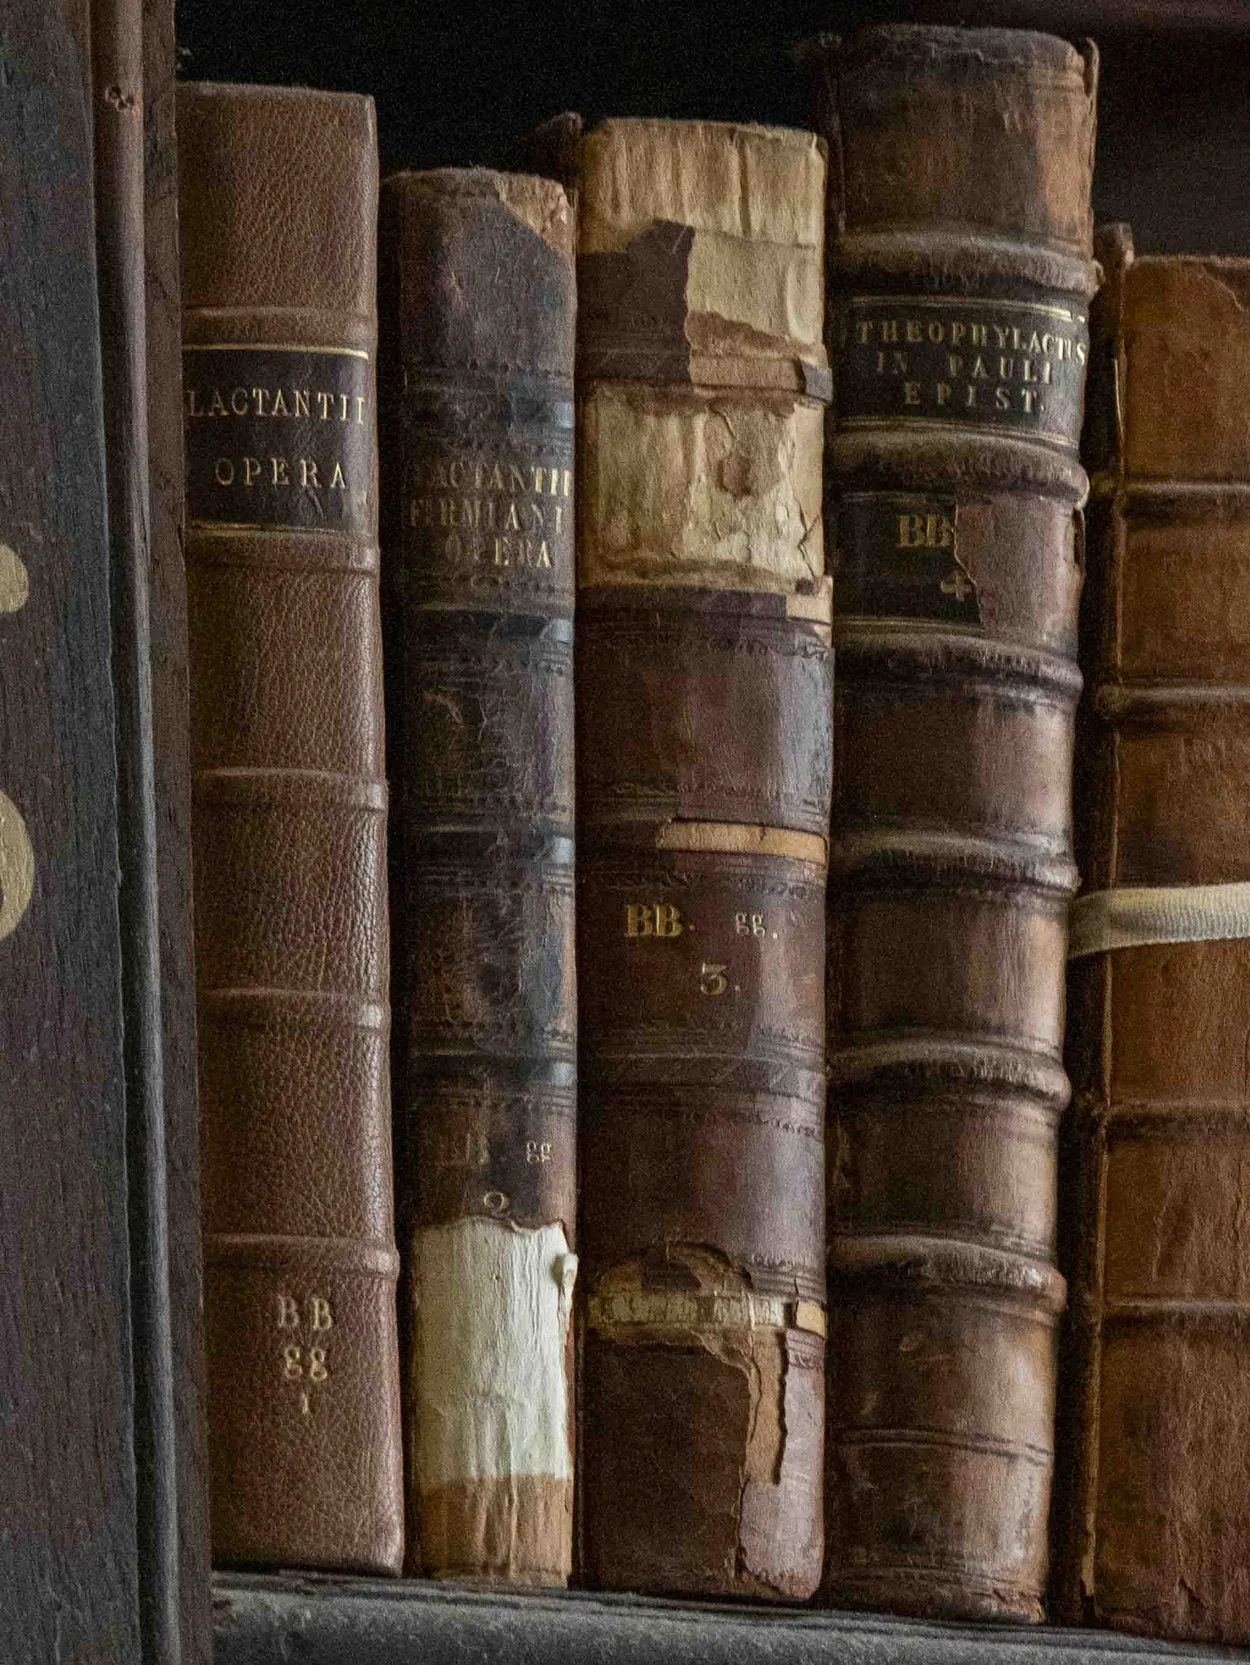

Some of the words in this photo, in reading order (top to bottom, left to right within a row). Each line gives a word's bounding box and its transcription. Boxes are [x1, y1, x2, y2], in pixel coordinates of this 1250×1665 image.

[951, 353, 1052, 385] PAULI
[187, 386, 367, 424] LACTANTII
[214, 456, 347, 490] OPERA
[276, 1294, 333, 1331] BB
